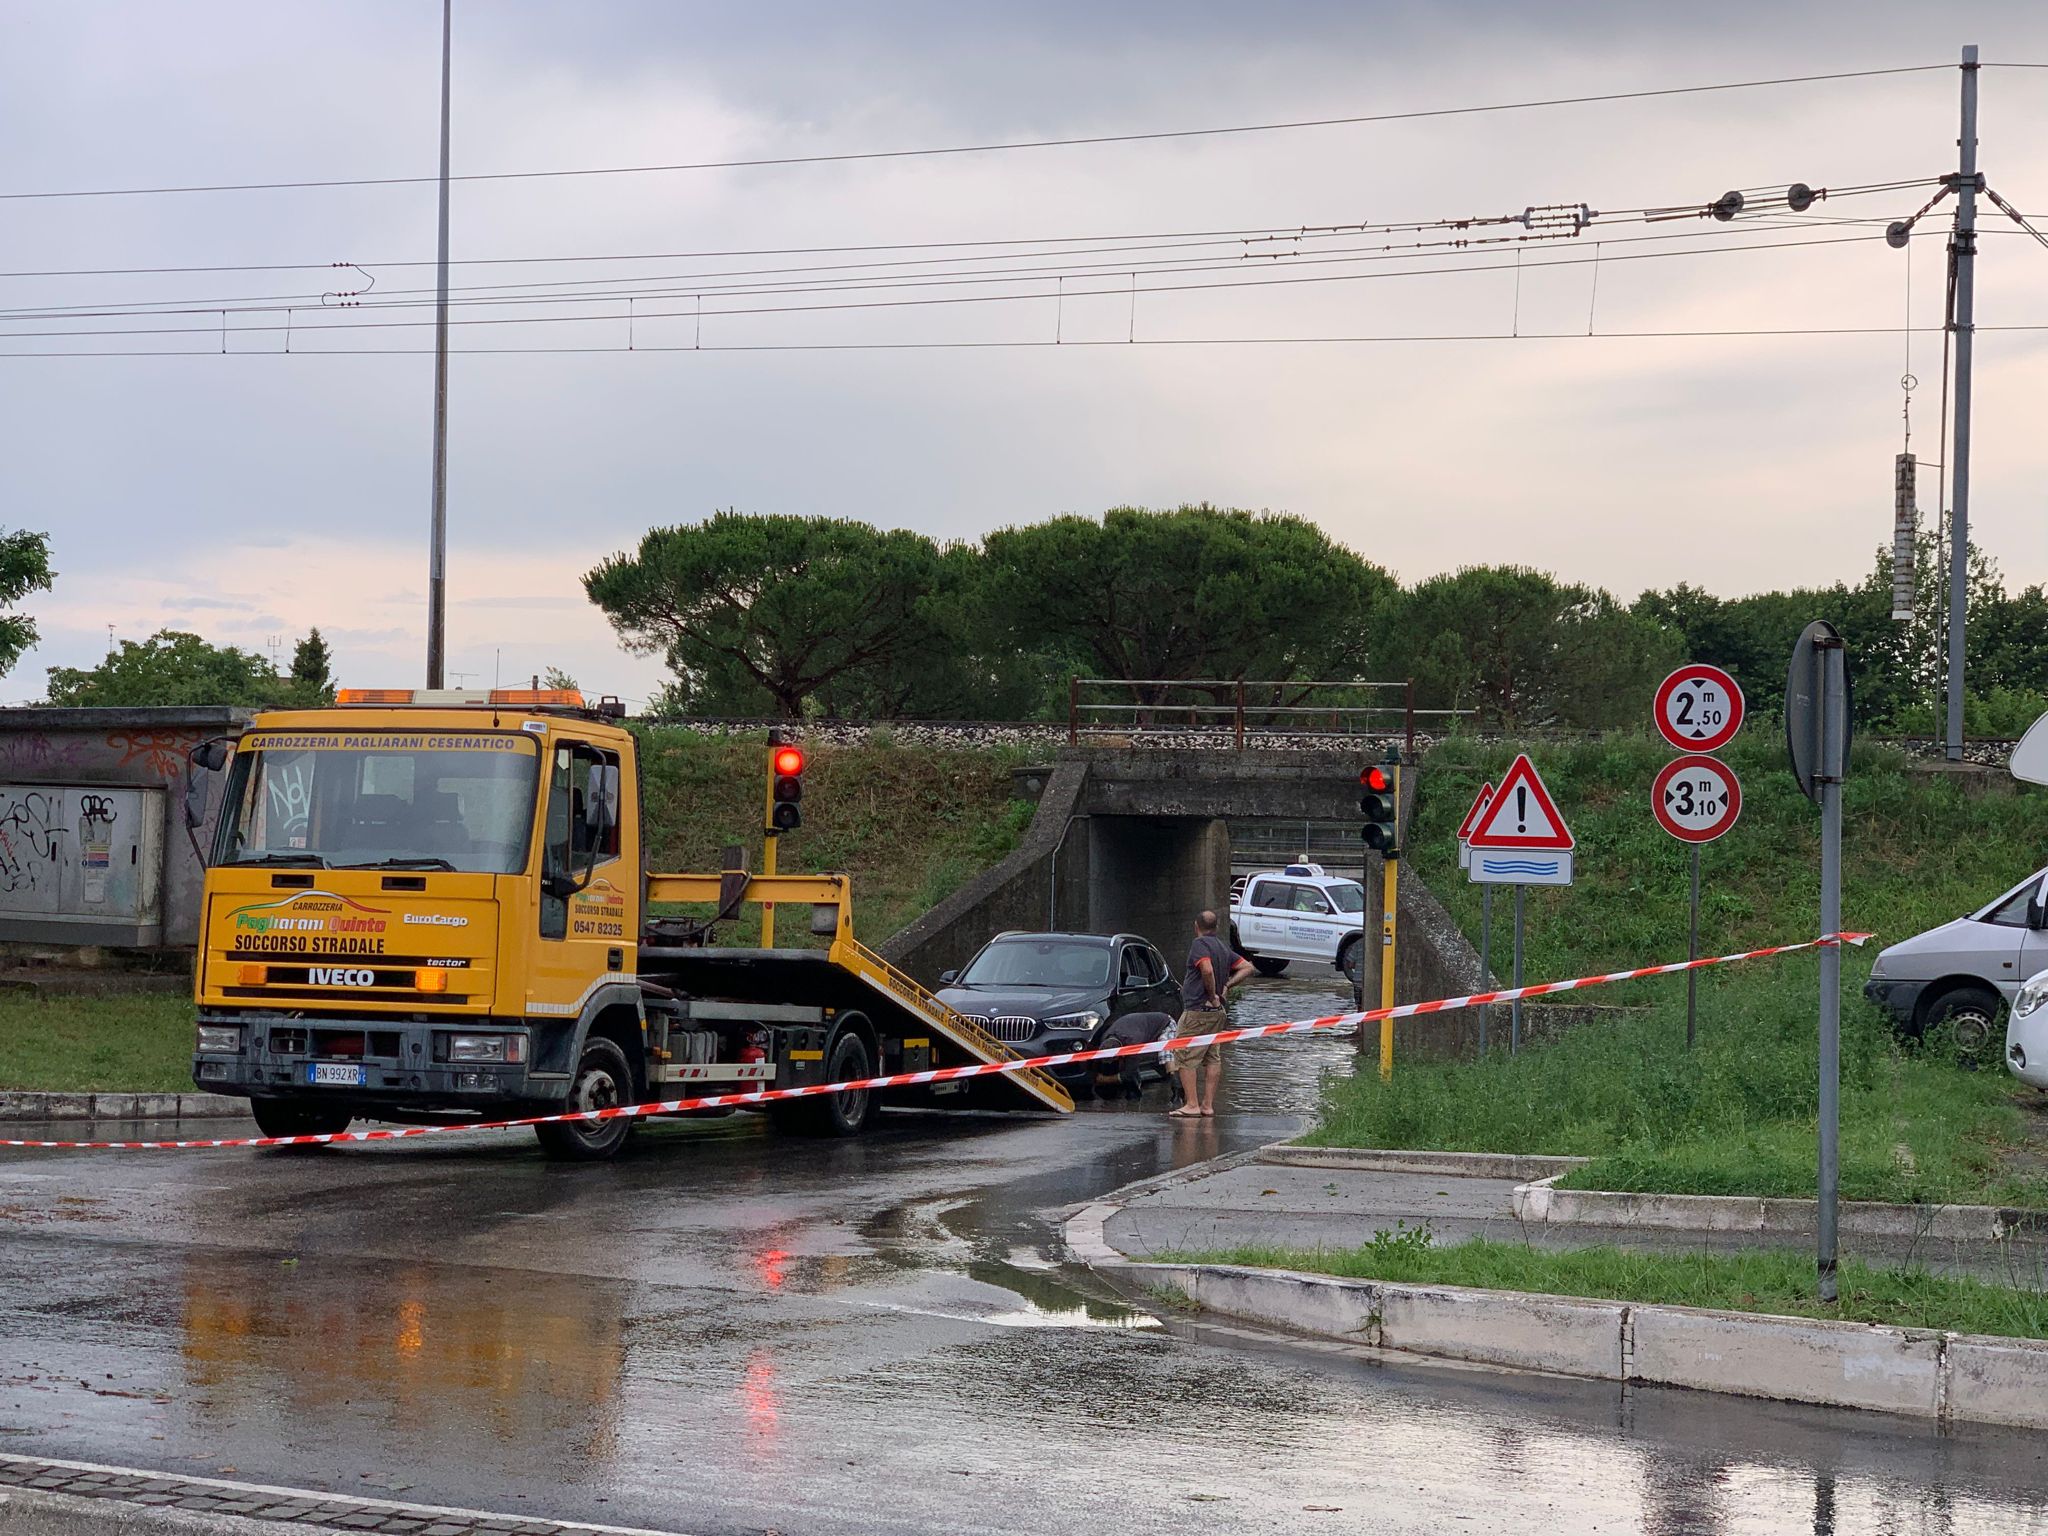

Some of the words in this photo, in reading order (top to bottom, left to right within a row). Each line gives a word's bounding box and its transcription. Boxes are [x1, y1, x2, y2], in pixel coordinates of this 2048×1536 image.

[251, 736, 339, 748] CARROZZERIA
[343, 737, 423, 748] PAGLIARANI
[428, 738, 514, 749] CESENATICO
[292, 902, 343, 912] CARROZZERIA
[575, 904, 599, 916] SOCCORSO
[601, 906, 623, 918] STRADALE
[236, 914, 324, 933] Pagliarani
[403, 914, 468, 926] EuroCargo
[574, 920, 596, 934] 0547
[597, 922, 623, 937] 82325
[235, 934, 307, 952] SOCCORSO
[312, 936, 385, 954] STRADALE
[427, 959, 466, 967] tector
[308, 968, 375, 987] IVECO
[888, 977, 918, 1004] SOCCORSO
[918, 998, 945, 1022] STRADALE
[948, 1017, 981, 1048] CARROZZERIA
[316, 1067, 328, 1080] BN
